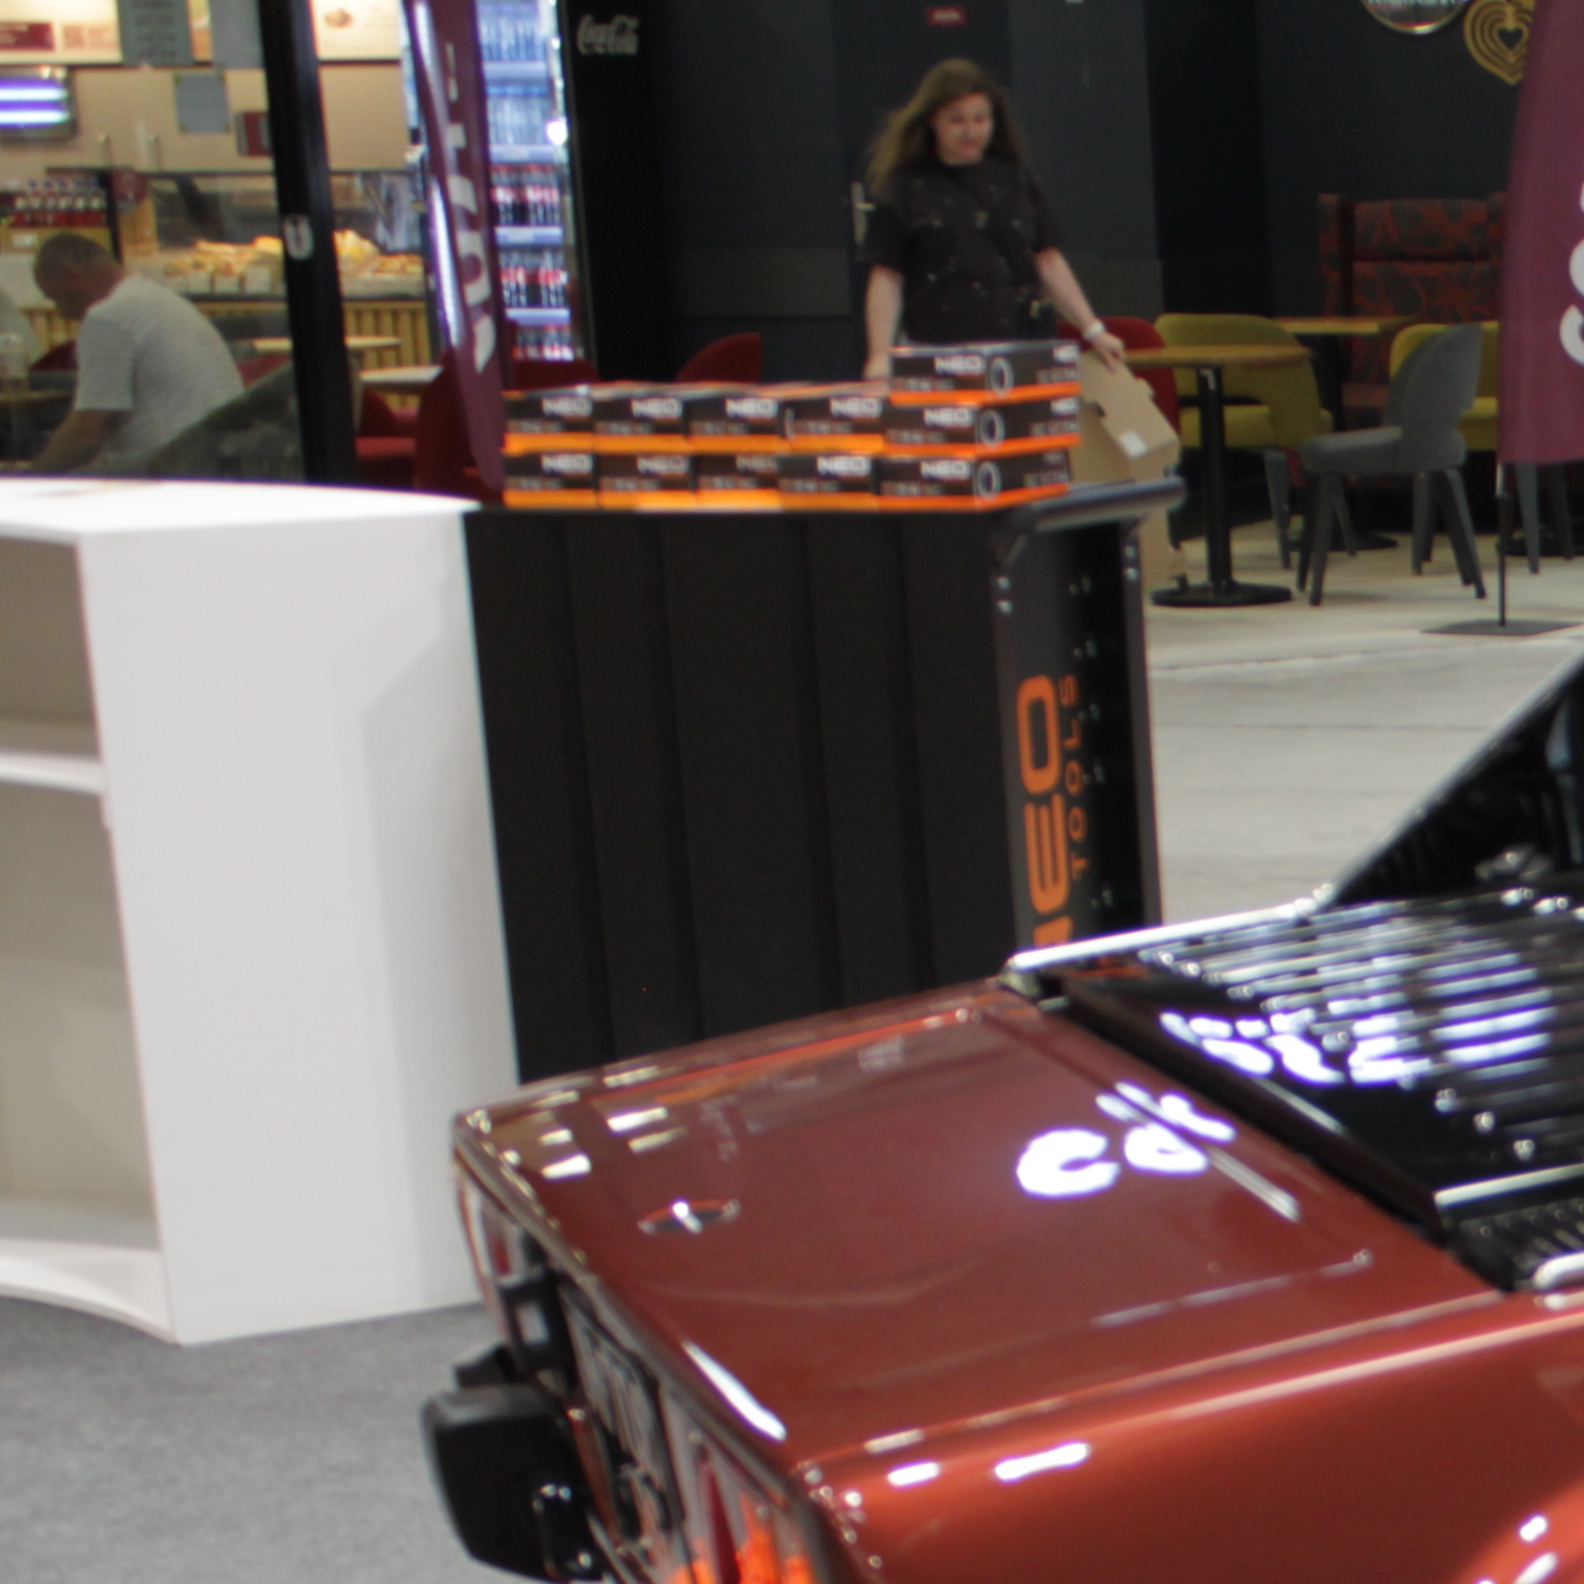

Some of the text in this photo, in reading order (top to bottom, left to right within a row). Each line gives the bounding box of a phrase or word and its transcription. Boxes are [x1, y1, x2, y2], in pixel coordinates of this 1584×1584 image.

[934, 354, 987, 375] NEO
[542, 396, 593, 418] NEO
[631, 397, 683, 419] NEO
[725, 397, 779, 419] NEO
[830, 396, 883, 419] NEO
[923, 407, 976, 428] NEO
[541, 453, 593, 474] NEO
[636, 454, 690, 475] NEO
[816, 454, 872, 477] NEO
[920, 459, 972, 480] NEO
[1057, 673, 1089, 881] TOOLS
